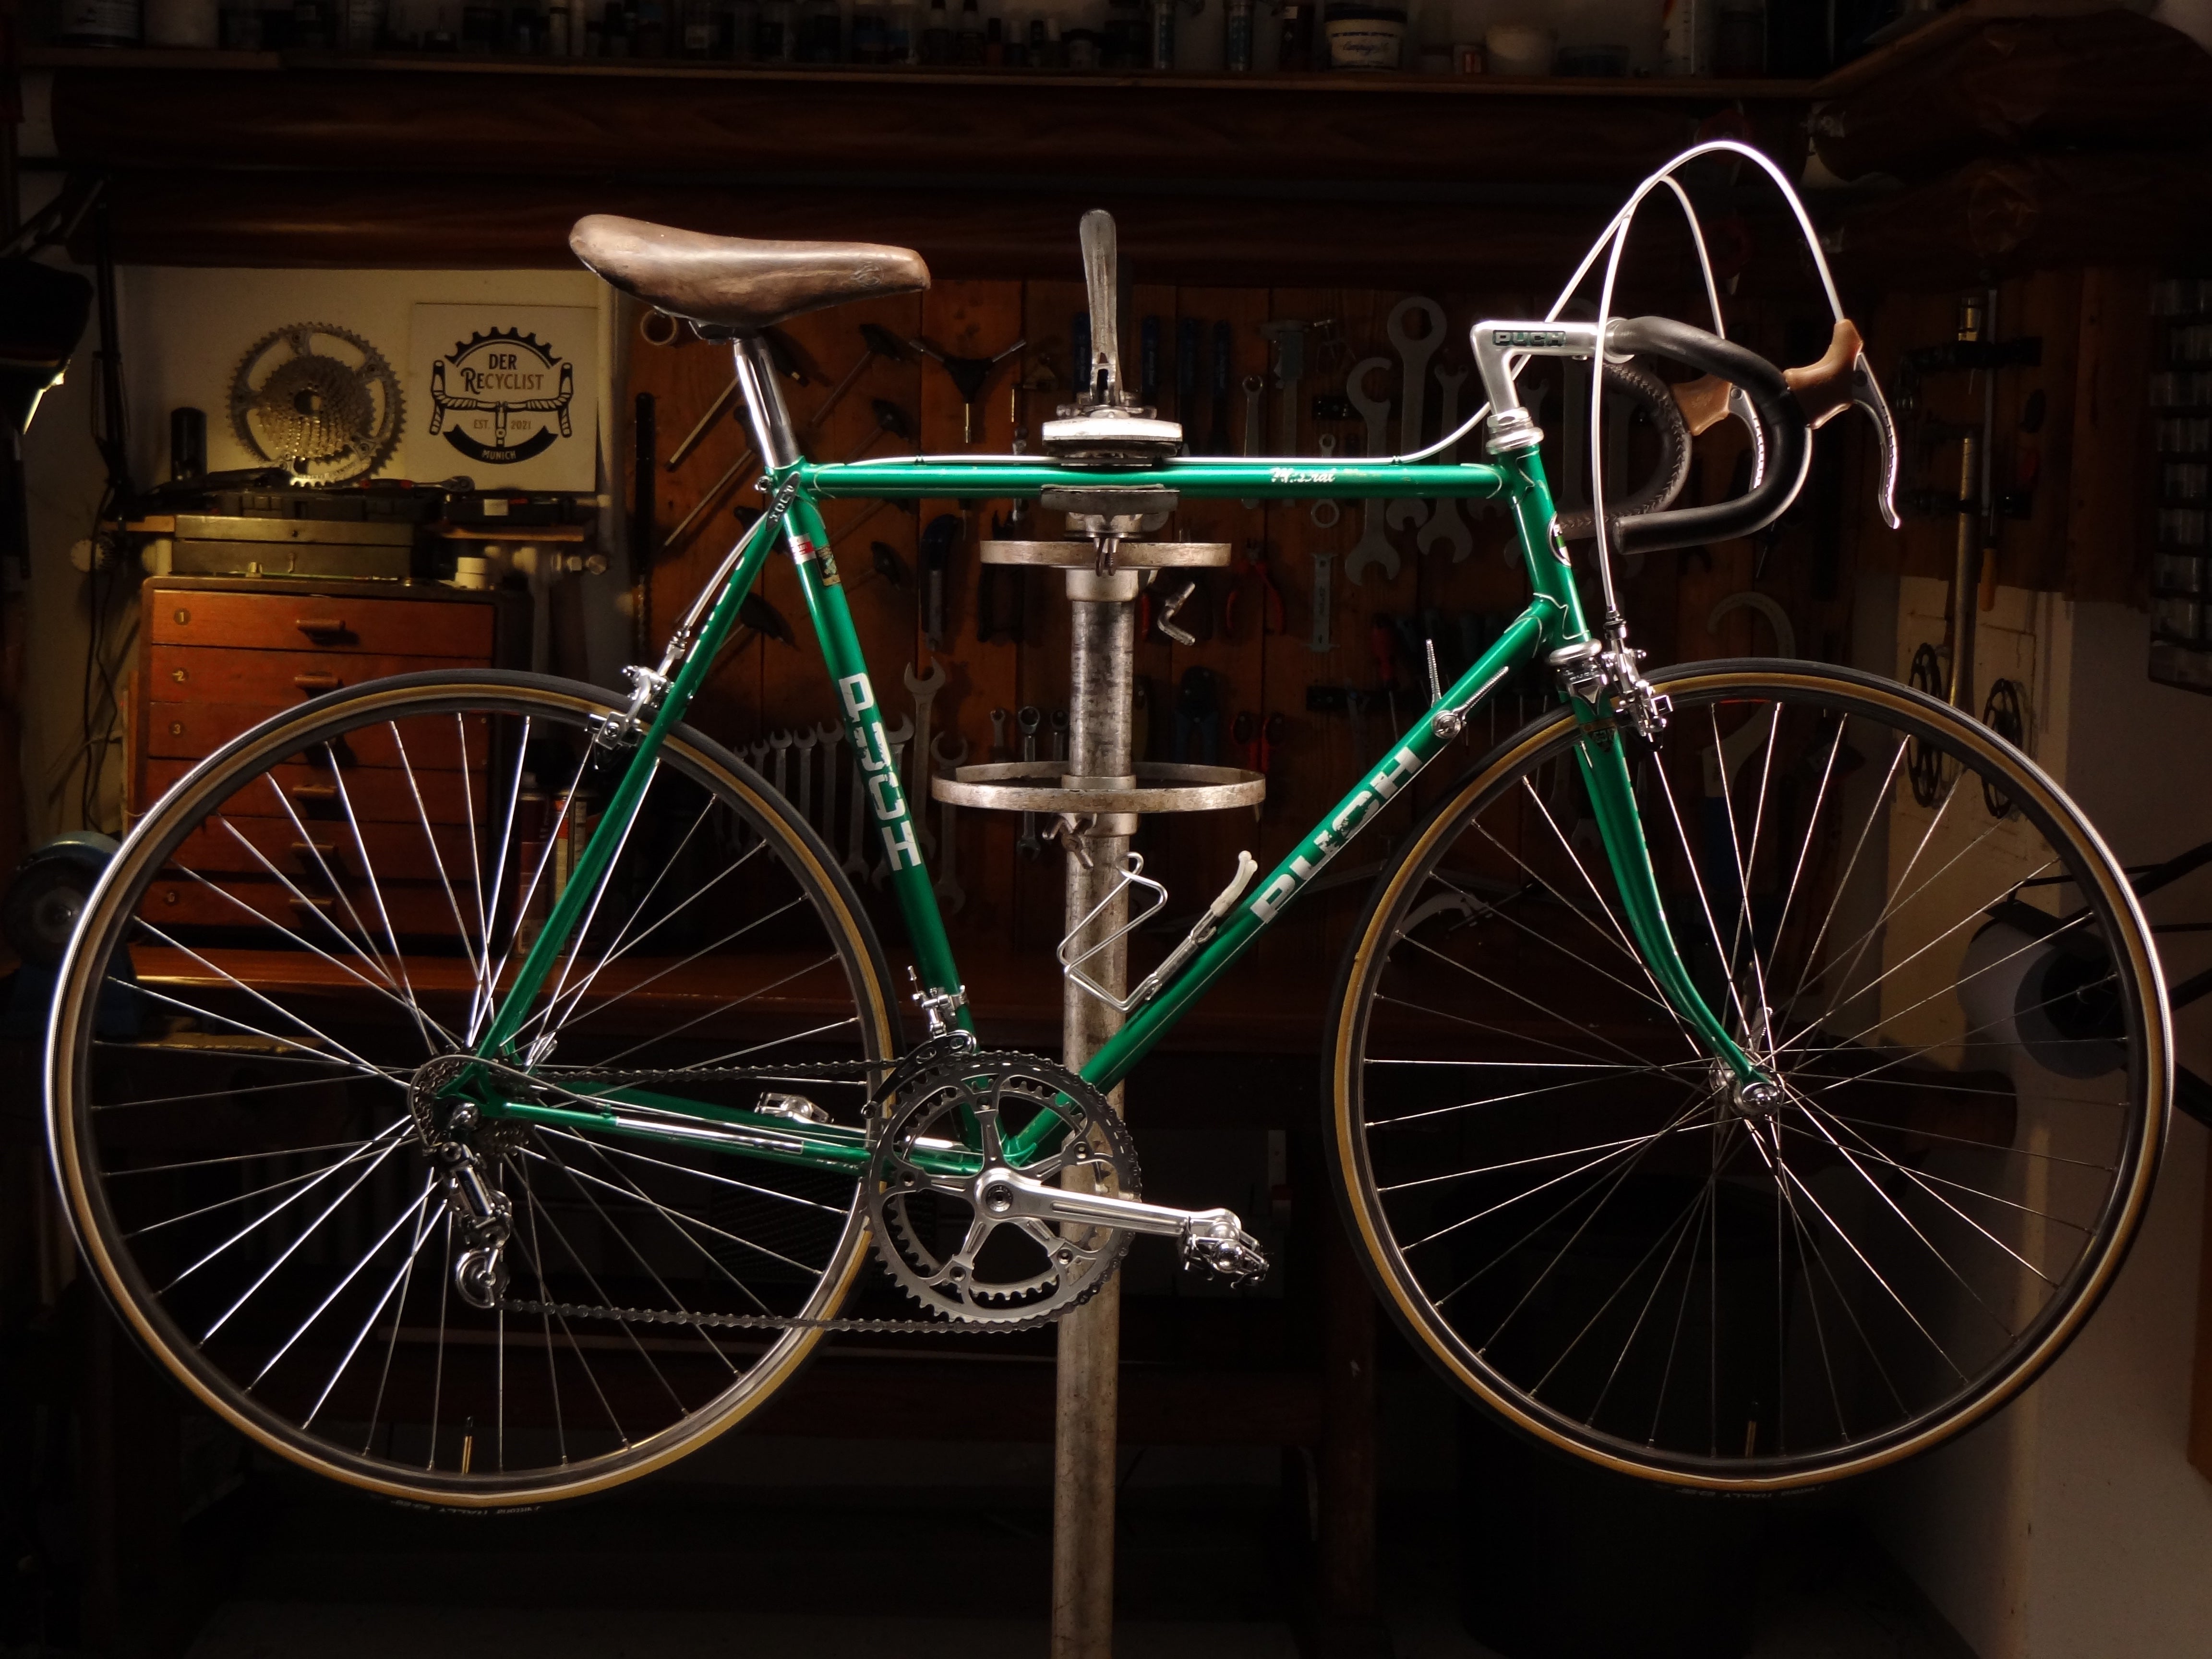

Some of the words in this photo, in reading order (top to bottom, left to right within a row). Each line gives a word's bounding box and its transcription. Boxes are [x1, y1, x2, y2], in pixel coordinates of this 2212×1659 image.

[1495, 331, 1565, 346] PUCH
[489, 353, 517, 370] DER
[461, 367, 544, 394] RECYCLIST
[474, 420, 490, 429] EST.
[511, 420, 531, 430] 2021
[481, 450, 516, 460] MUNICH
[173, 724, 181, 734] 3
[839, 673, 921, 871] PUCH
[1250, 746, 1422, 924] PUCH
